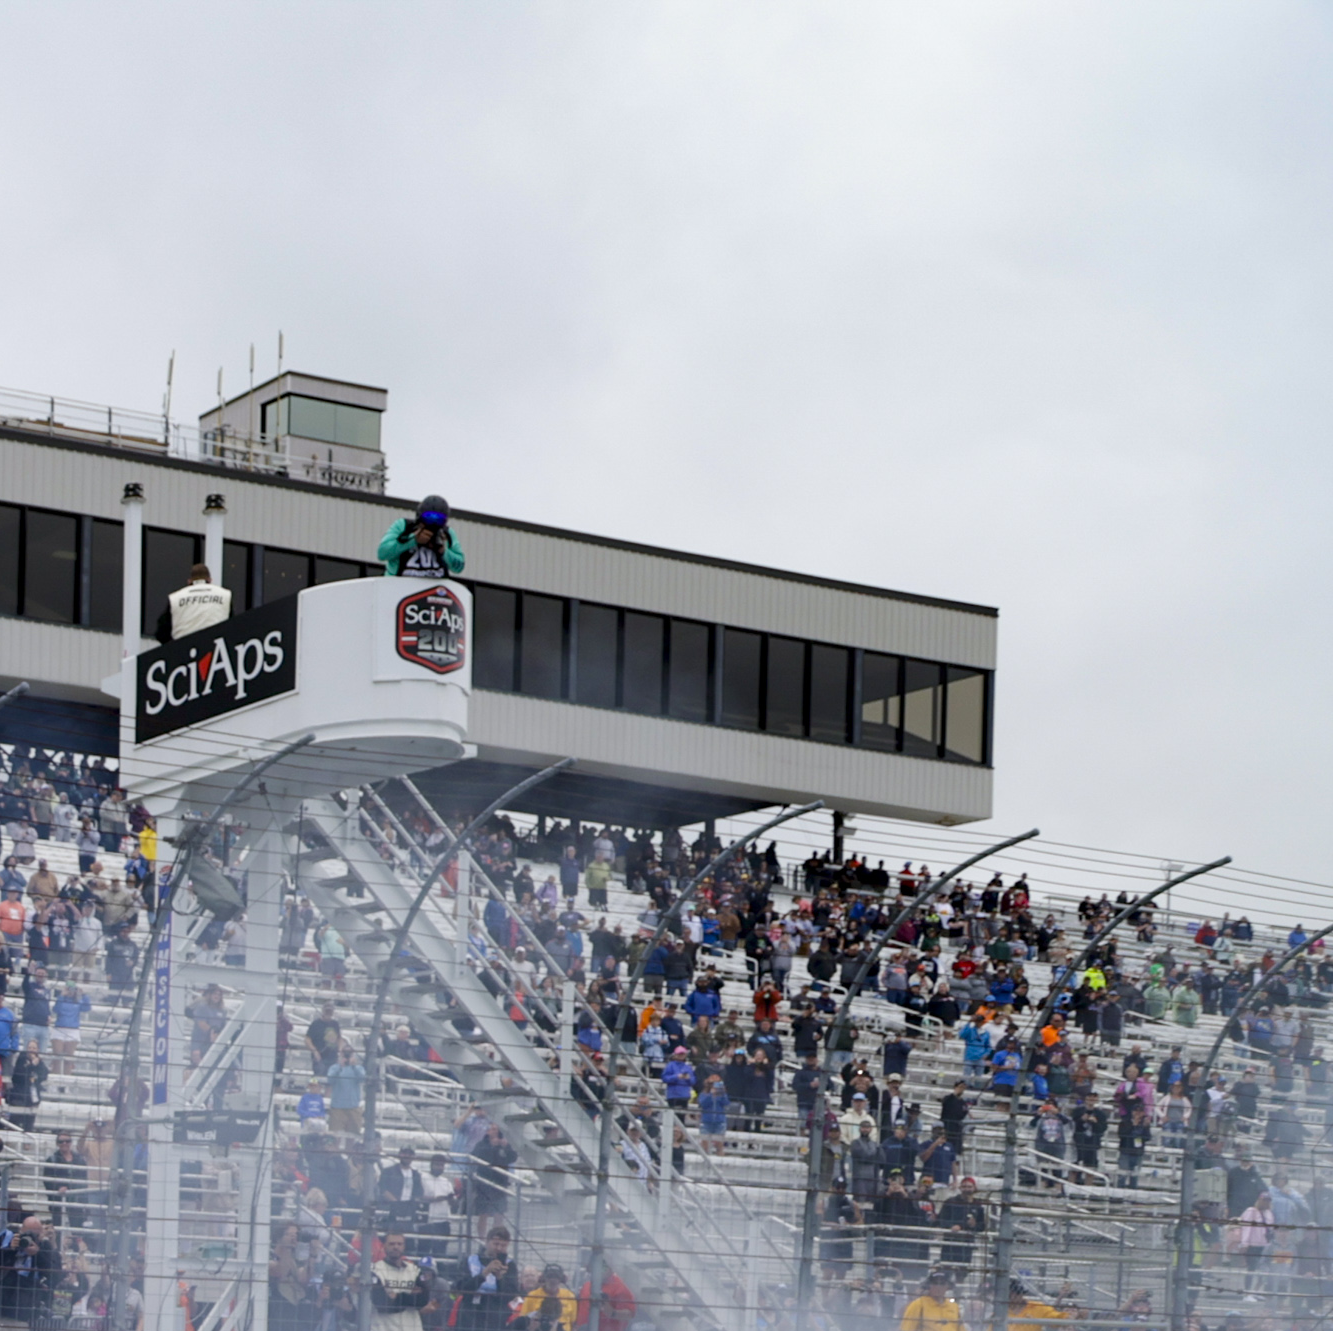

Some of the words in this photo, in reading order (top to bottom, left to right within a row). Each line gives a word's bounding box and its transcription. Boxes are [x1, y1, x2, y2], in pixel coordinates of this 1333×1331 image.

[178, 595, 224, 607] OFFICIAL
[405, 604, 464, 633] SciAps
[418, 629, 458, 655] 200
[144, 629, 285, 716] SciAps
[153, 898, 171, 1074] HMS.COM
